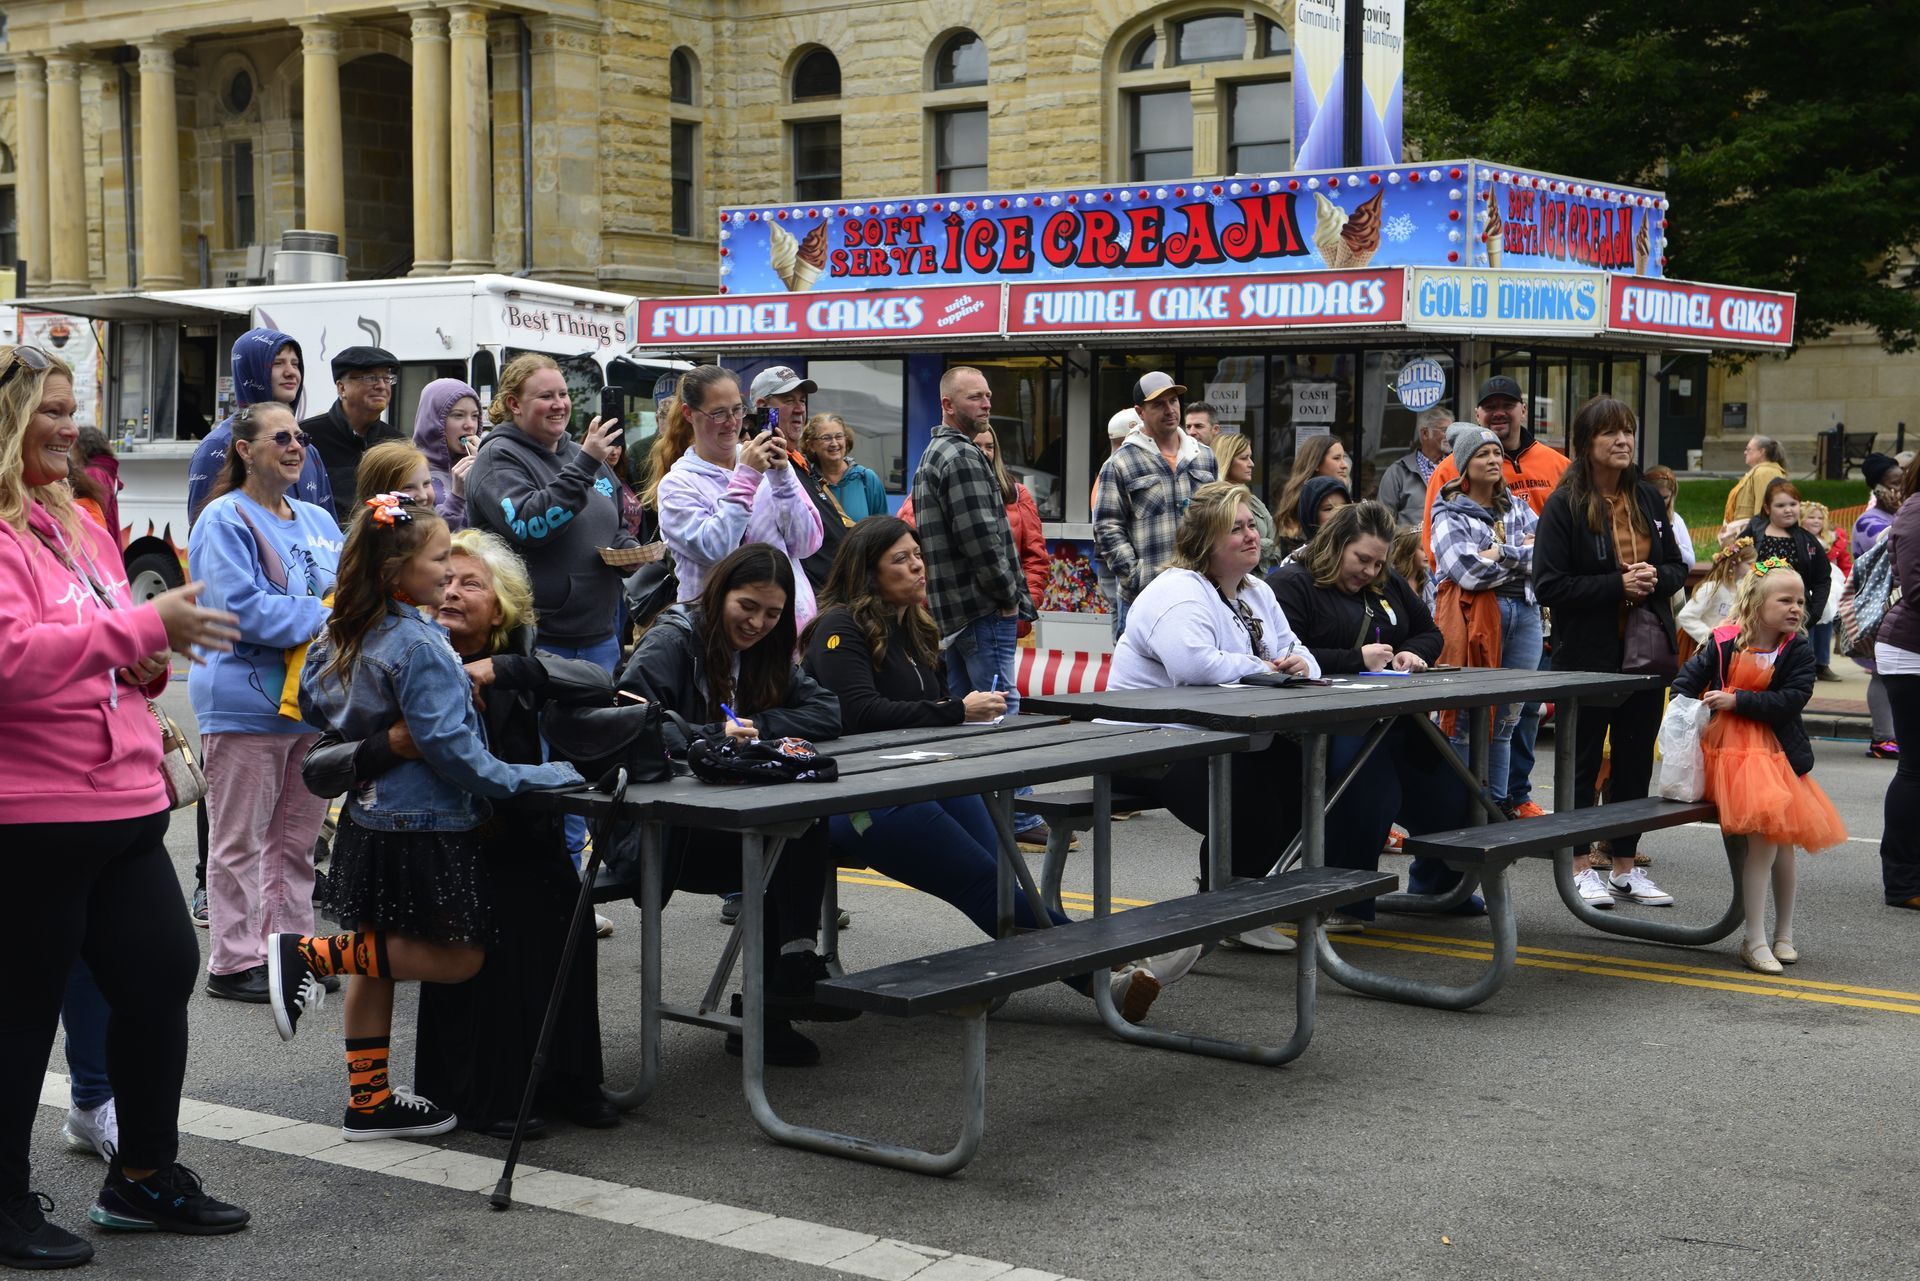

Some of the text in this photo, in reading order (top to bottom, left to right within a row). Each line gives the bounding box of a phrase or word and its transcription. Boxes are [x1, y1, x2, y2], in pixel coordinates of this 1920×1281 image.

[1362, 6, 1392, 30] rowing
[1508, 188, 1536, 222] SOFT
[844, 215, 925, 248] SOFT
[1041, 194, 1310, 268] CREAM
[1503, 221, 1539, 256] SERVE
[1567, 202, 1635, 271] CREAM
[830, 245, 938, 278] SERVE
[937, 299, 986, 329] toppings
[944, 294, 972, 313] with
[1022, 278, 1386, 325] FUNNEL CAKE SUNDAES
[1418, 275, 1597, 321] COLD DRINKS
[1620, 285, 1784, 336] FUNNEL CAKES
[507, 305, 549, 331] Best
[552, 312, 611, 346] Thing
[651, 296, 924, 337] FUNNEL CAKES
[1397, 363, 1443, 387] BOTTLED
[1211, 390, 1239, 400] CASH
[1299, 390, 1329, 400] CASH
[1299, 404, 1329, 415] ONLY
[1401, 387, 1440, 407] WATER
